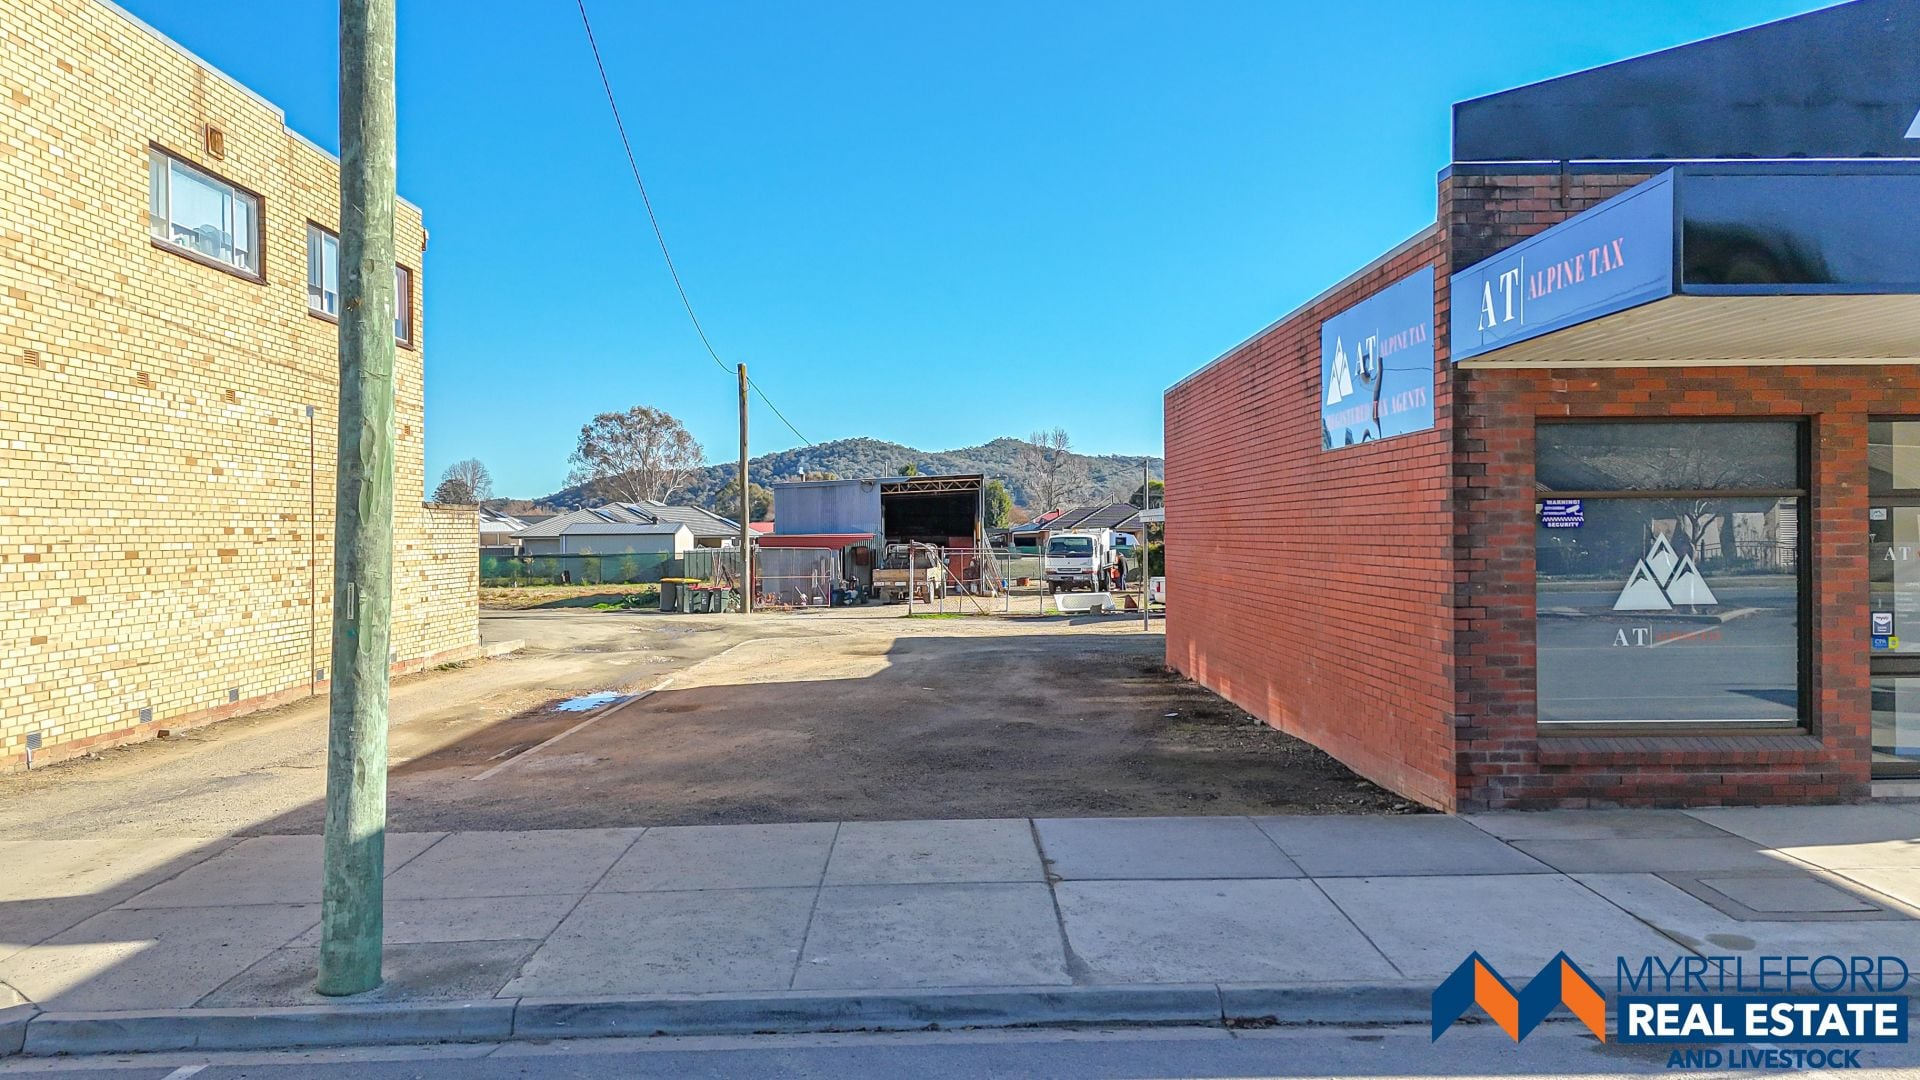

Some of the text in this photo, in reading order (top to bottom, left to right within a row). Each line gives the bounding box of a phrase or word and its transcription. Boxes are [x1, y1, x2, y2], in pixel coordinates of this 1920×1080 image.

[1478, 237, 1624, 331] AT ALPINE TAX
[1355, 322, 1426, 376] AT ALPINE TAX
[1391, 386, 1426, 415] AGENTS
[1884, 546, 1912, 560] AT
[1612, 627, 1648, 647] AT
